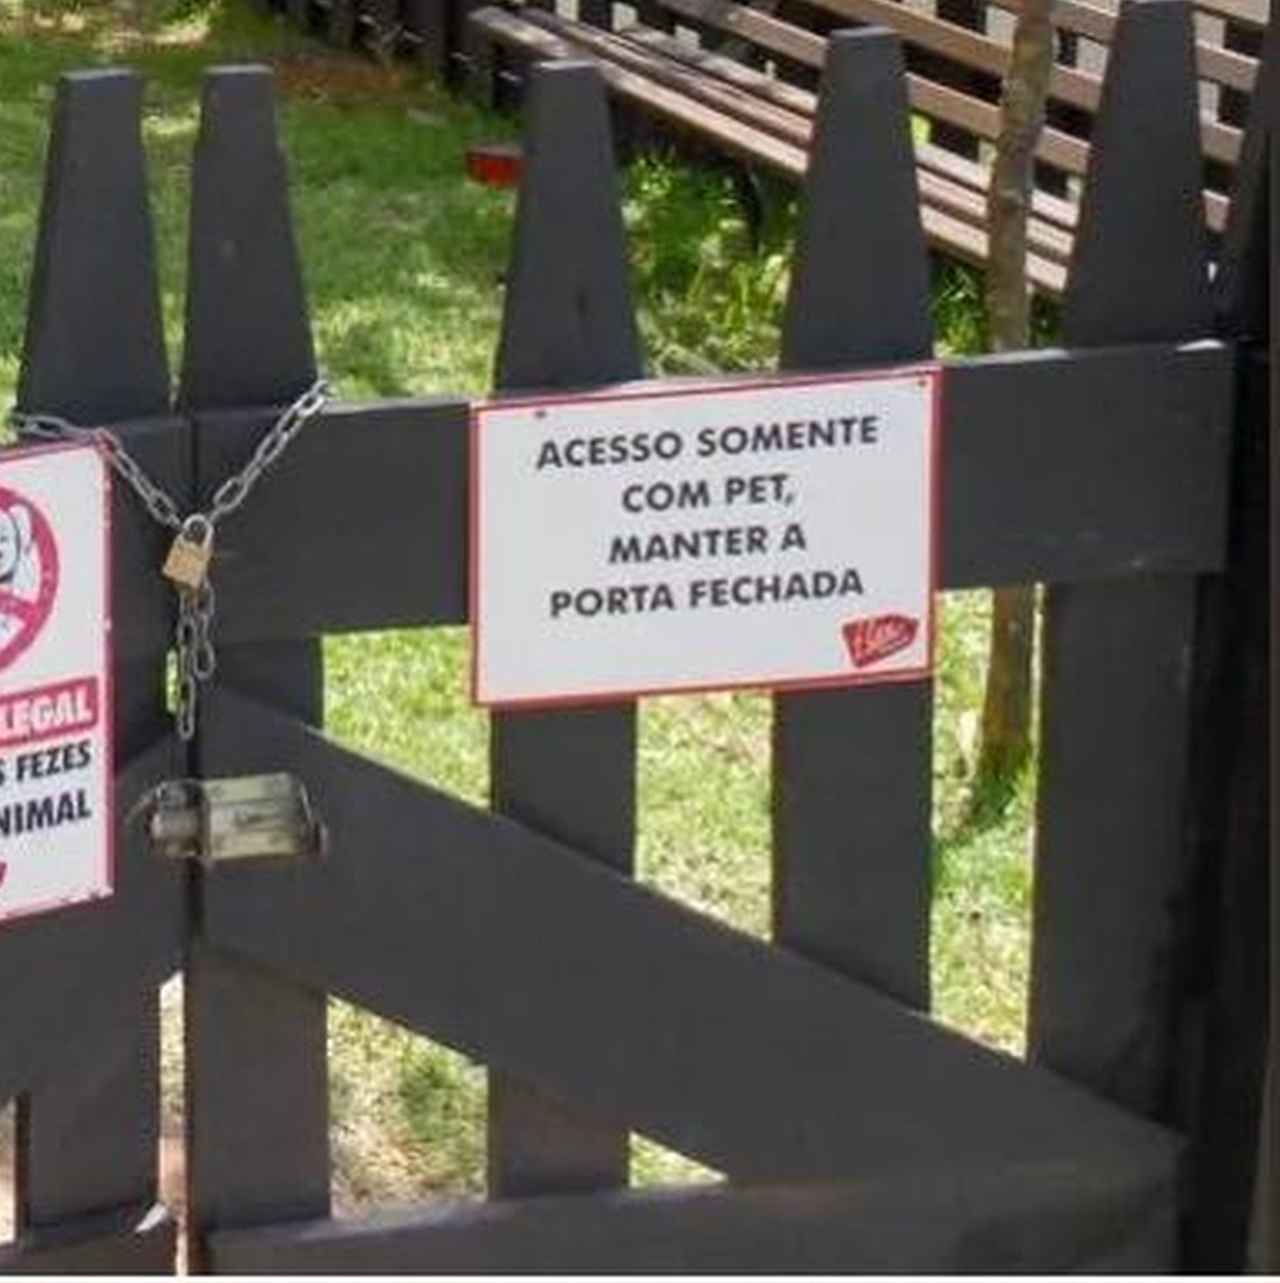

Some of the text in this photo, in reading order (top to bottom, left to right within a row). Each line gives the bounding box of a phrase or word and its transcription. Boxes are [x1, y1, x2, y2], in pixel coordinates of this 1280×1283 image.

[536, 415, 880, 470] ACESSO SOMENTE
[621, 474, 794, 513] COM PET,
[607, 522, 808, 565] MANTER A
[550, 568, 864, 619] PORTA FECHADA
[15, 738, 92, 783] FEZES
